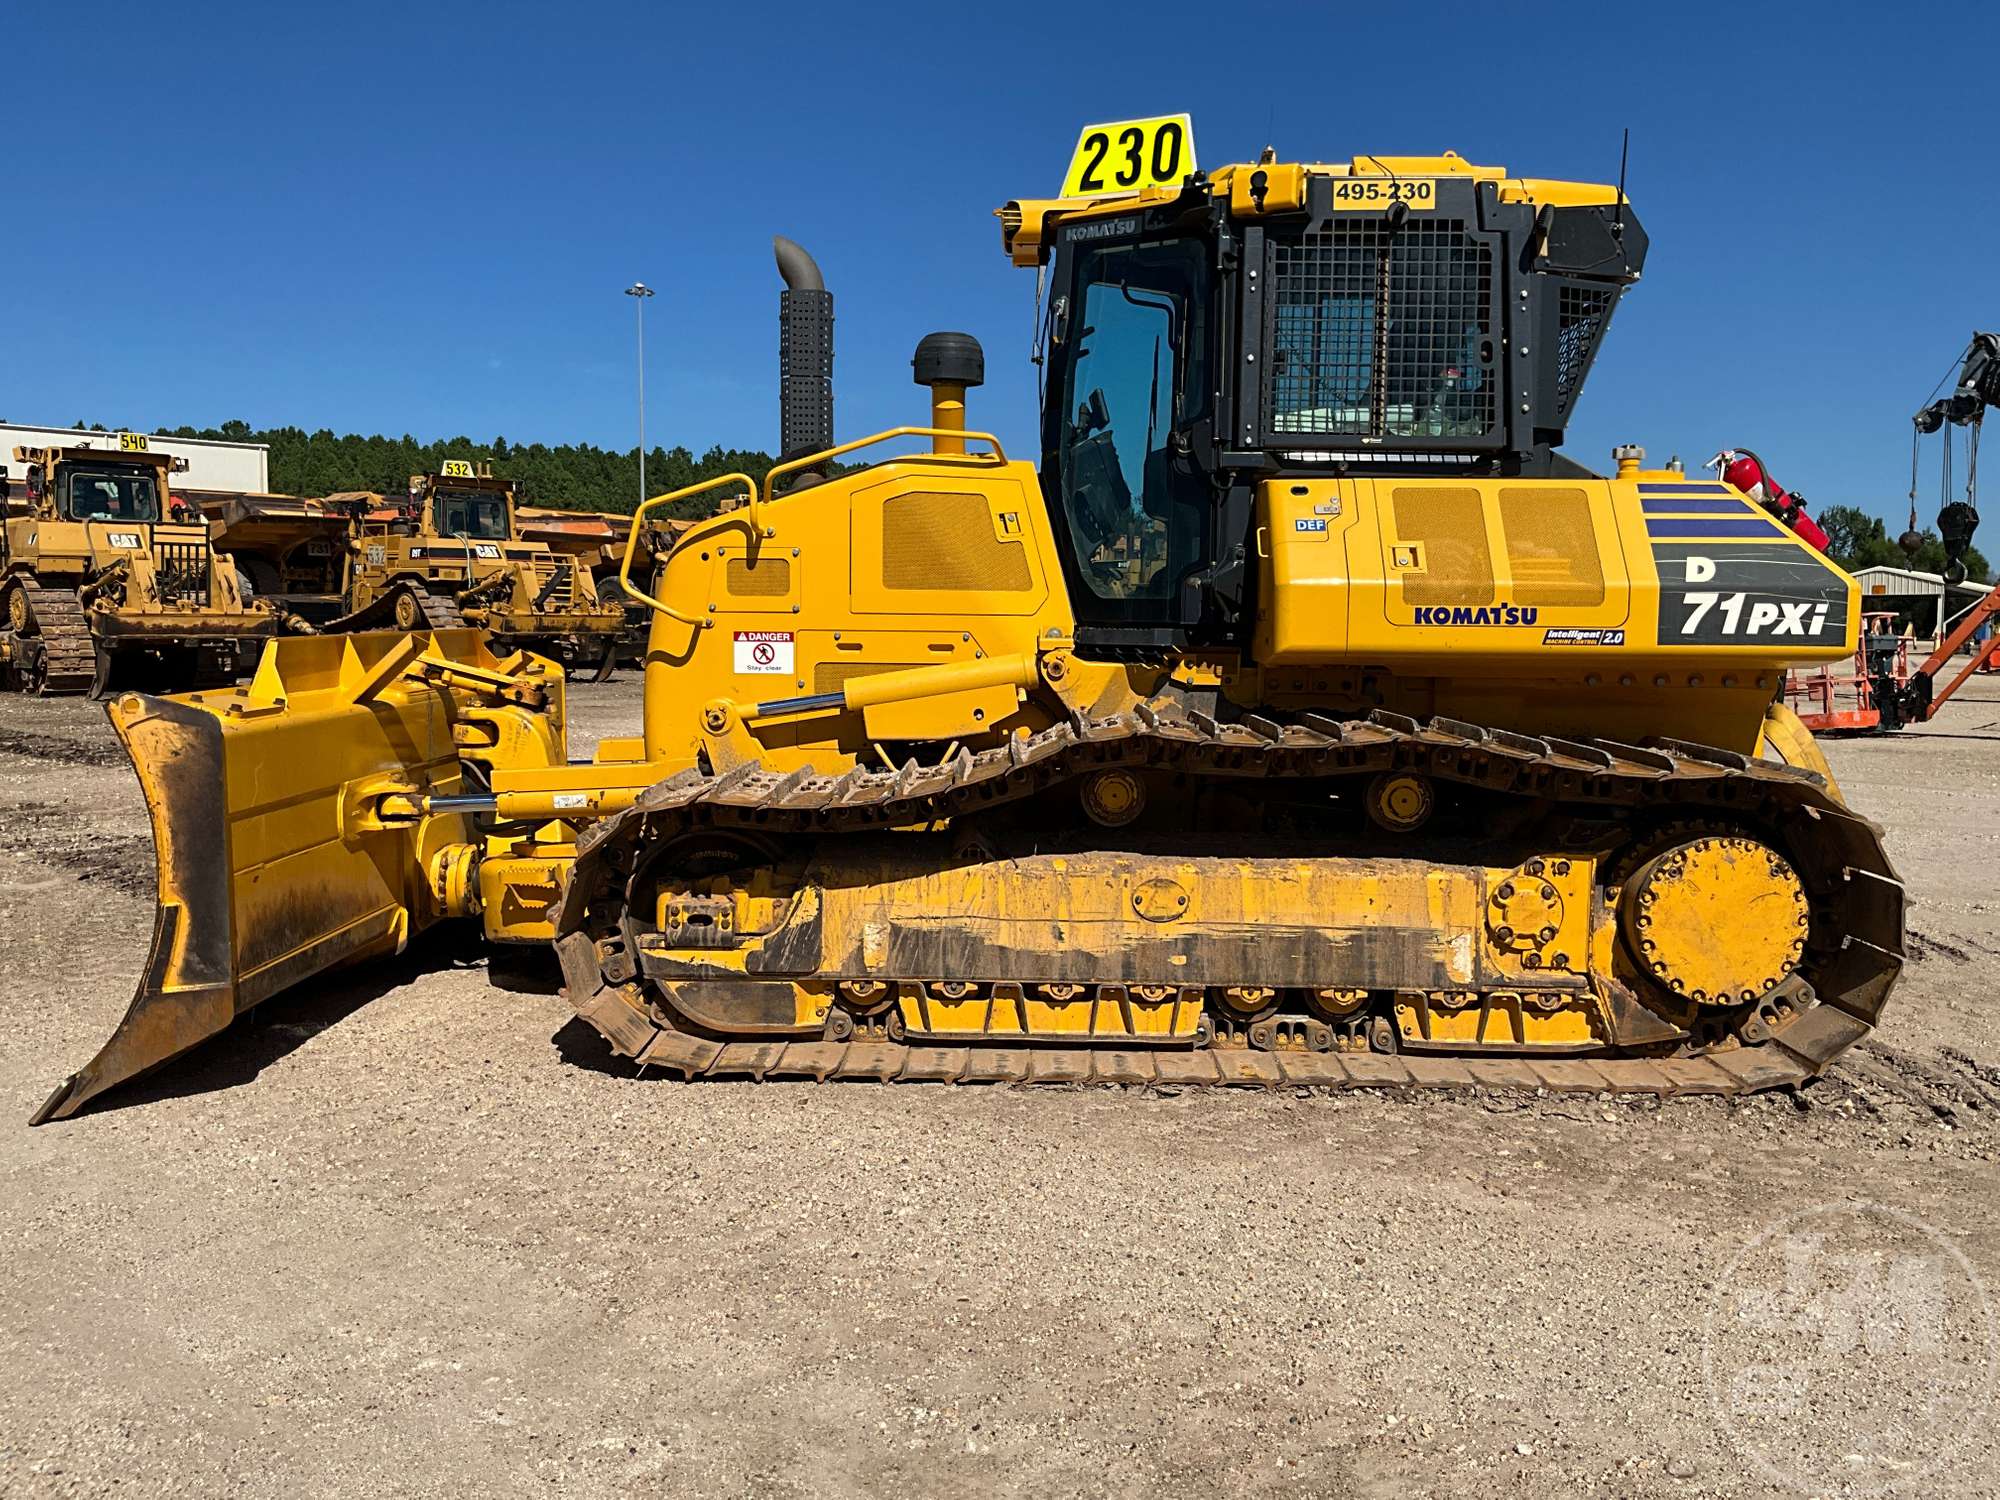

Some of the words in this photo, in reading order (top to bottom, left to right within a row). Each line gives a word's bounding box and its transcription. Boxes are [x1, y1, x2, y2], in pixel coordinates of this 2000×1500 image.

[1079, 122, 1183, 192] 230
[1336, 182, 1432, 201] 495-230
[1065, 218, 1136, 242] KOMATSU
[121, 434, 147, 450] 540
[446, 463, 469, 476] 532
[1296, 520, 1325, 531] DEF
[109, 534, 139, 548] CAT
[476, 545, 500, 558] CAT
[1685, 556, 1717, 583] D
[1414, 602, 1538, 625] KOMATSU
[1680, 592, 1830, 636] 71PXi
[748, 632, 790, 641] DANGER
[1602, 632, 1623, 644] 2.0
